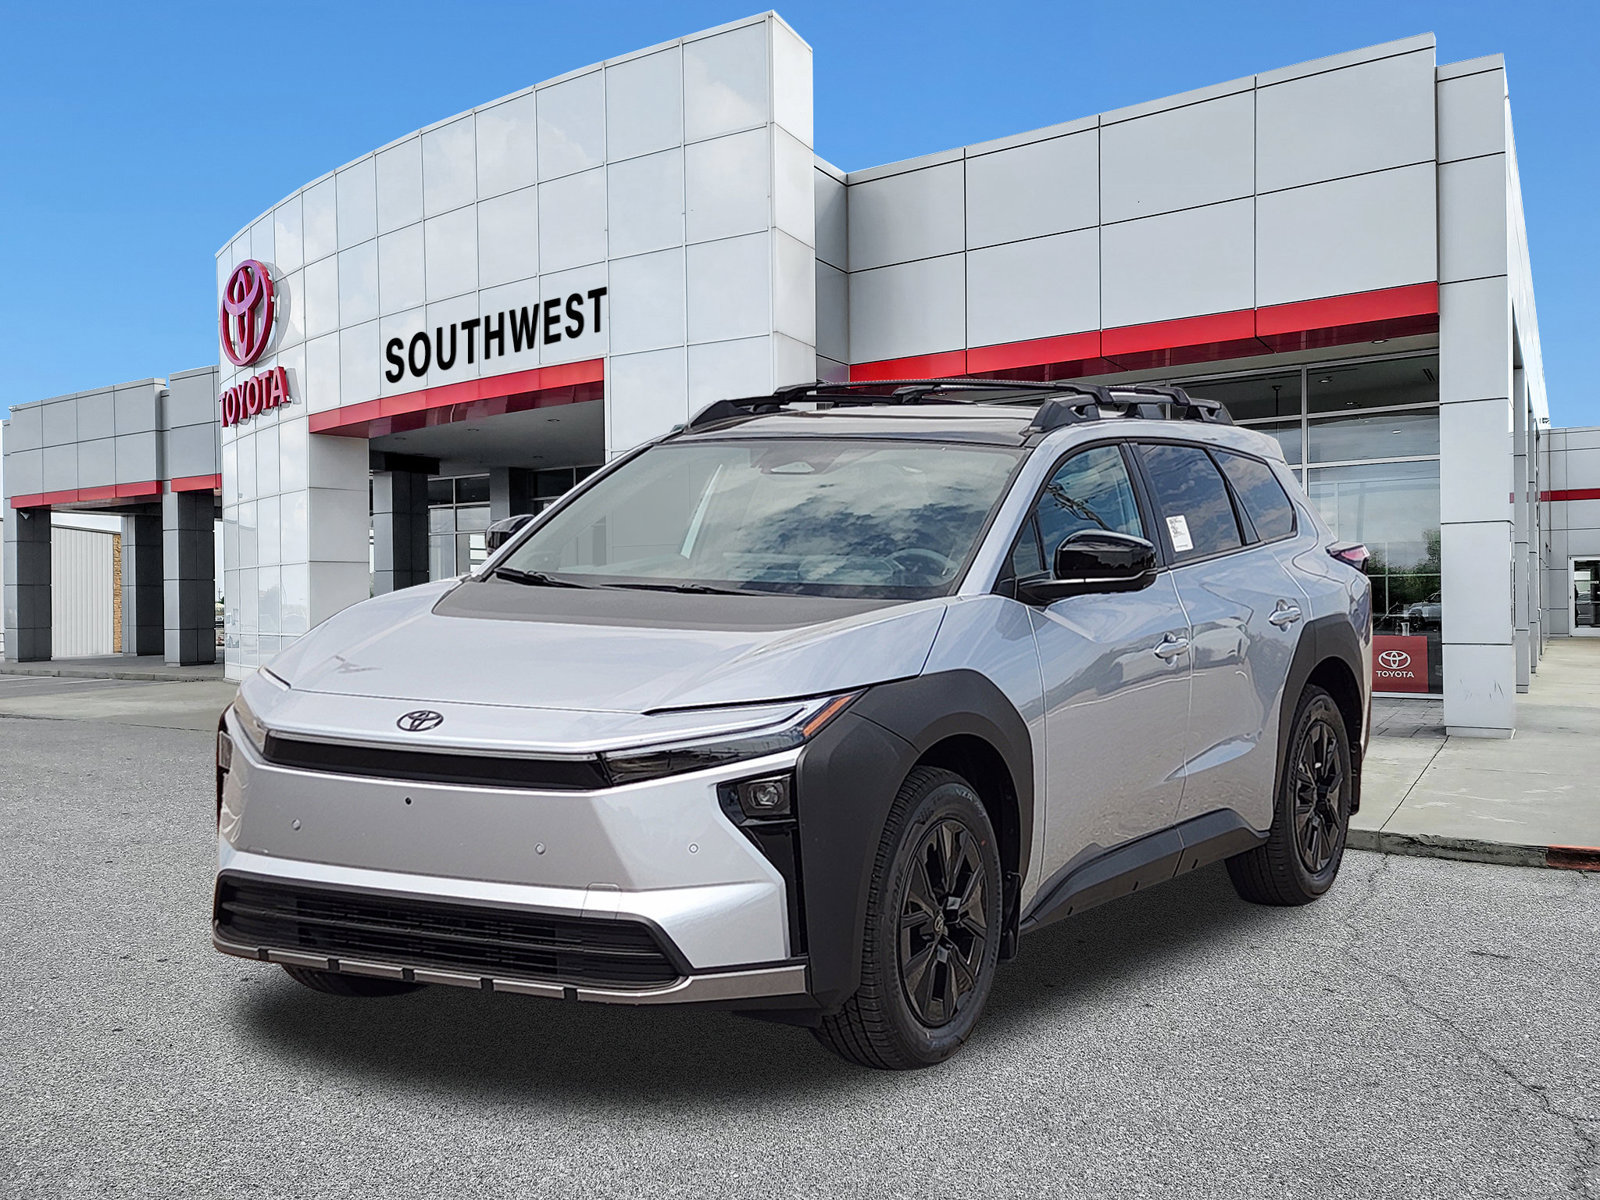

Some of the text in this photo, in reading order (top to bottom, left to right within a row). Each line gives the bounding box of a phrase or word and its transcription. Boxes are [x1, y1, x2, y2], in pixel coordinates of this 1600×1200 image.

[385, 287, 607, 383] SOUTHWEST
[219, 366, 289, 427] TOYOTA
[1376, 670, 1414, 678] TOYOTA
